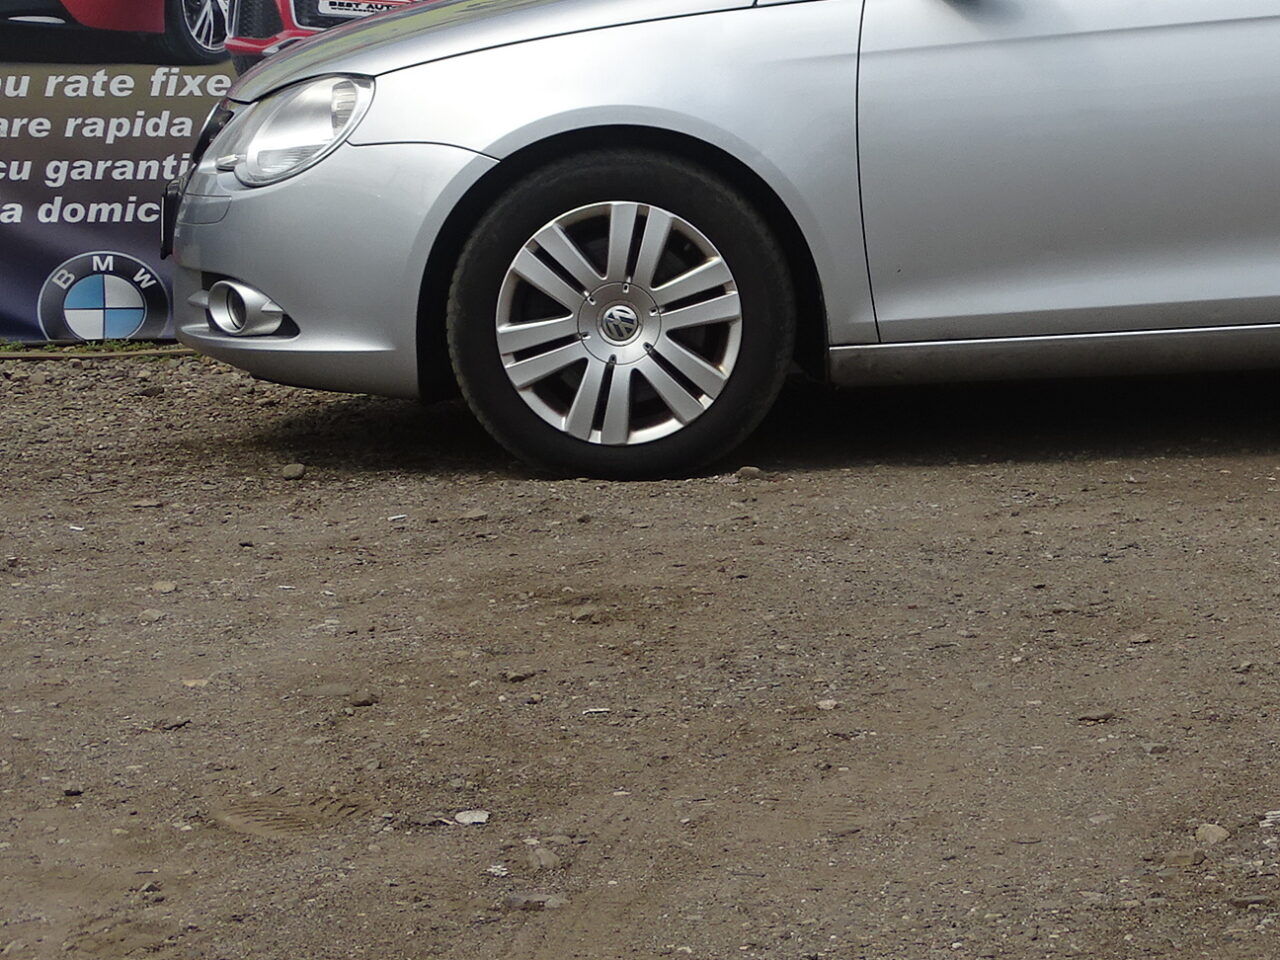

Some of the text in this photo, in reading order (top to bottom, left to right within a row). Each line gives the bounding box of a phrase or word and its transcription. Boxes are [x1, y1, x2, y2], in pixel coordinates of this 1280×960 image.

[45, 69, 134, 96] rate
[150, 67, 231, 96] fixe
[65, 111, 192, 143] rapida
